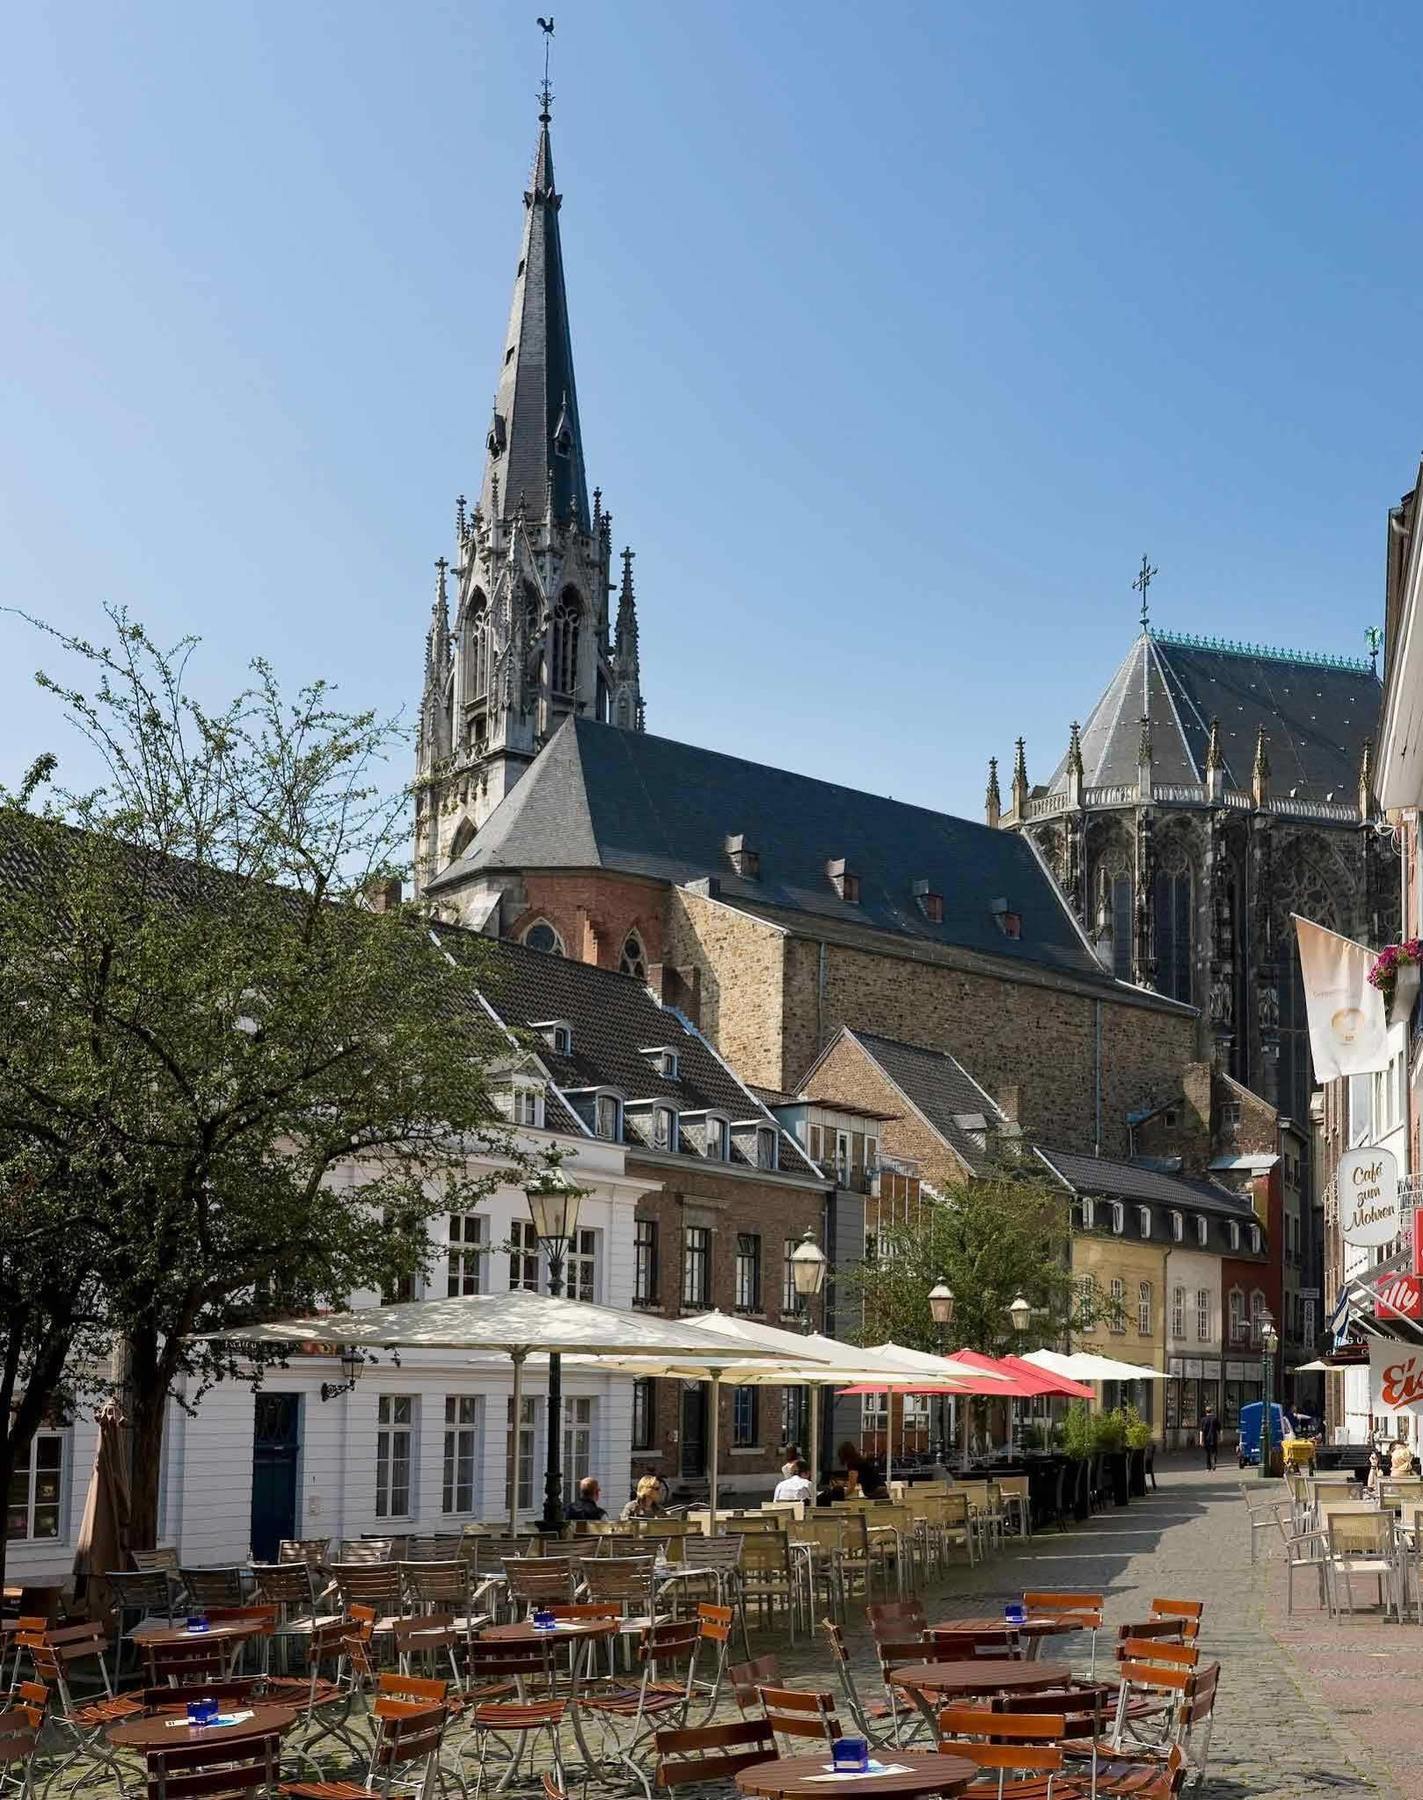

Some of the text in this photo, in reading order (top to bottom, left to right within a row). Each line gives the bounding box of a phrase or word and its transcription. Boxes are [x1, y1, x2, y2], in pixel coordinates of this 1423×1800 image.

[1352, 1161, 1383, 1186] Café
[1357, 1187, 1381, 1208] zum
[1343, 1205, 1395, 1232] Mohren
[1380, 1281, 1420, 1314] illy
